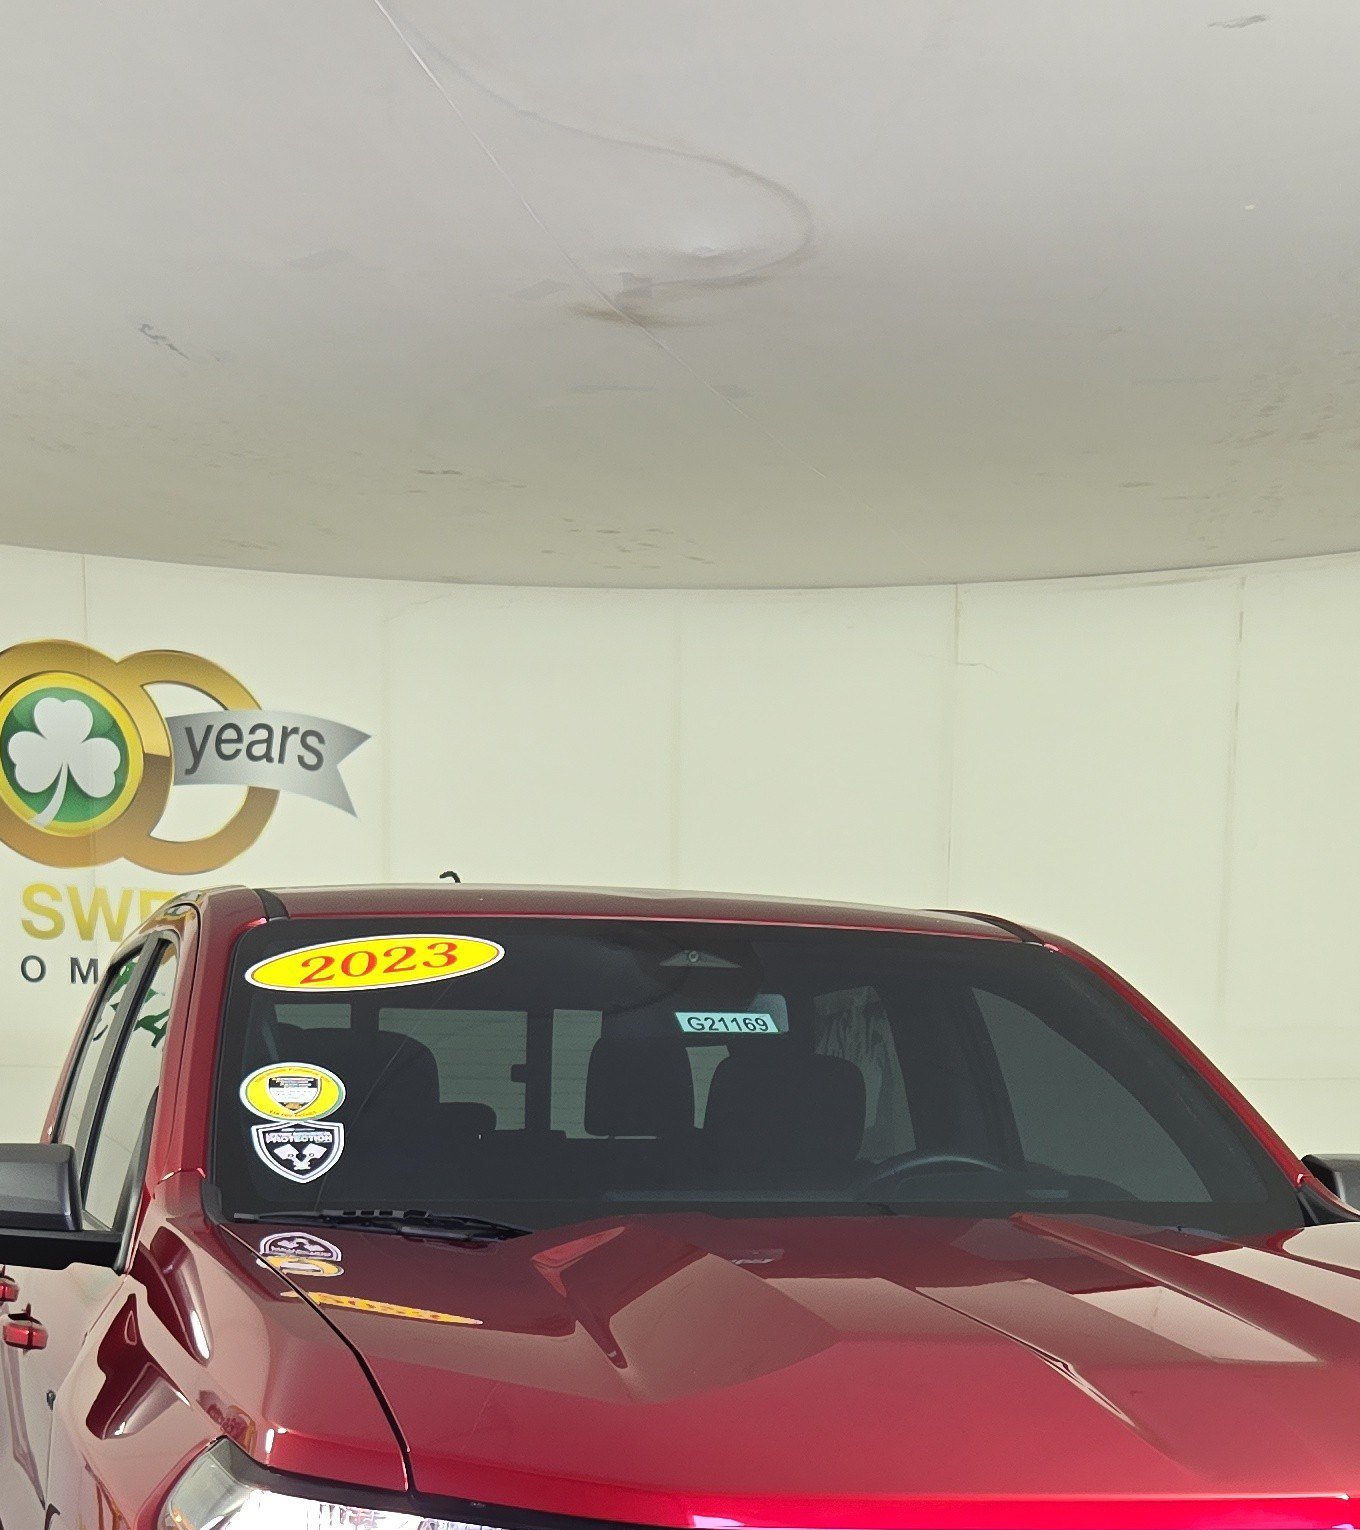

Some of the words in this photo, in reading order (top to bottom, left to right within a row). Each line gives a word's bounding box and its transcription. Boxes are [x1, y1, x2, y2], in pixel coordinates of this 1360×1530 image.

[183, 720, 327, 776] years
[299, 941, 459, 985] 2023
[687, 1016, 770, 1033] G21169
